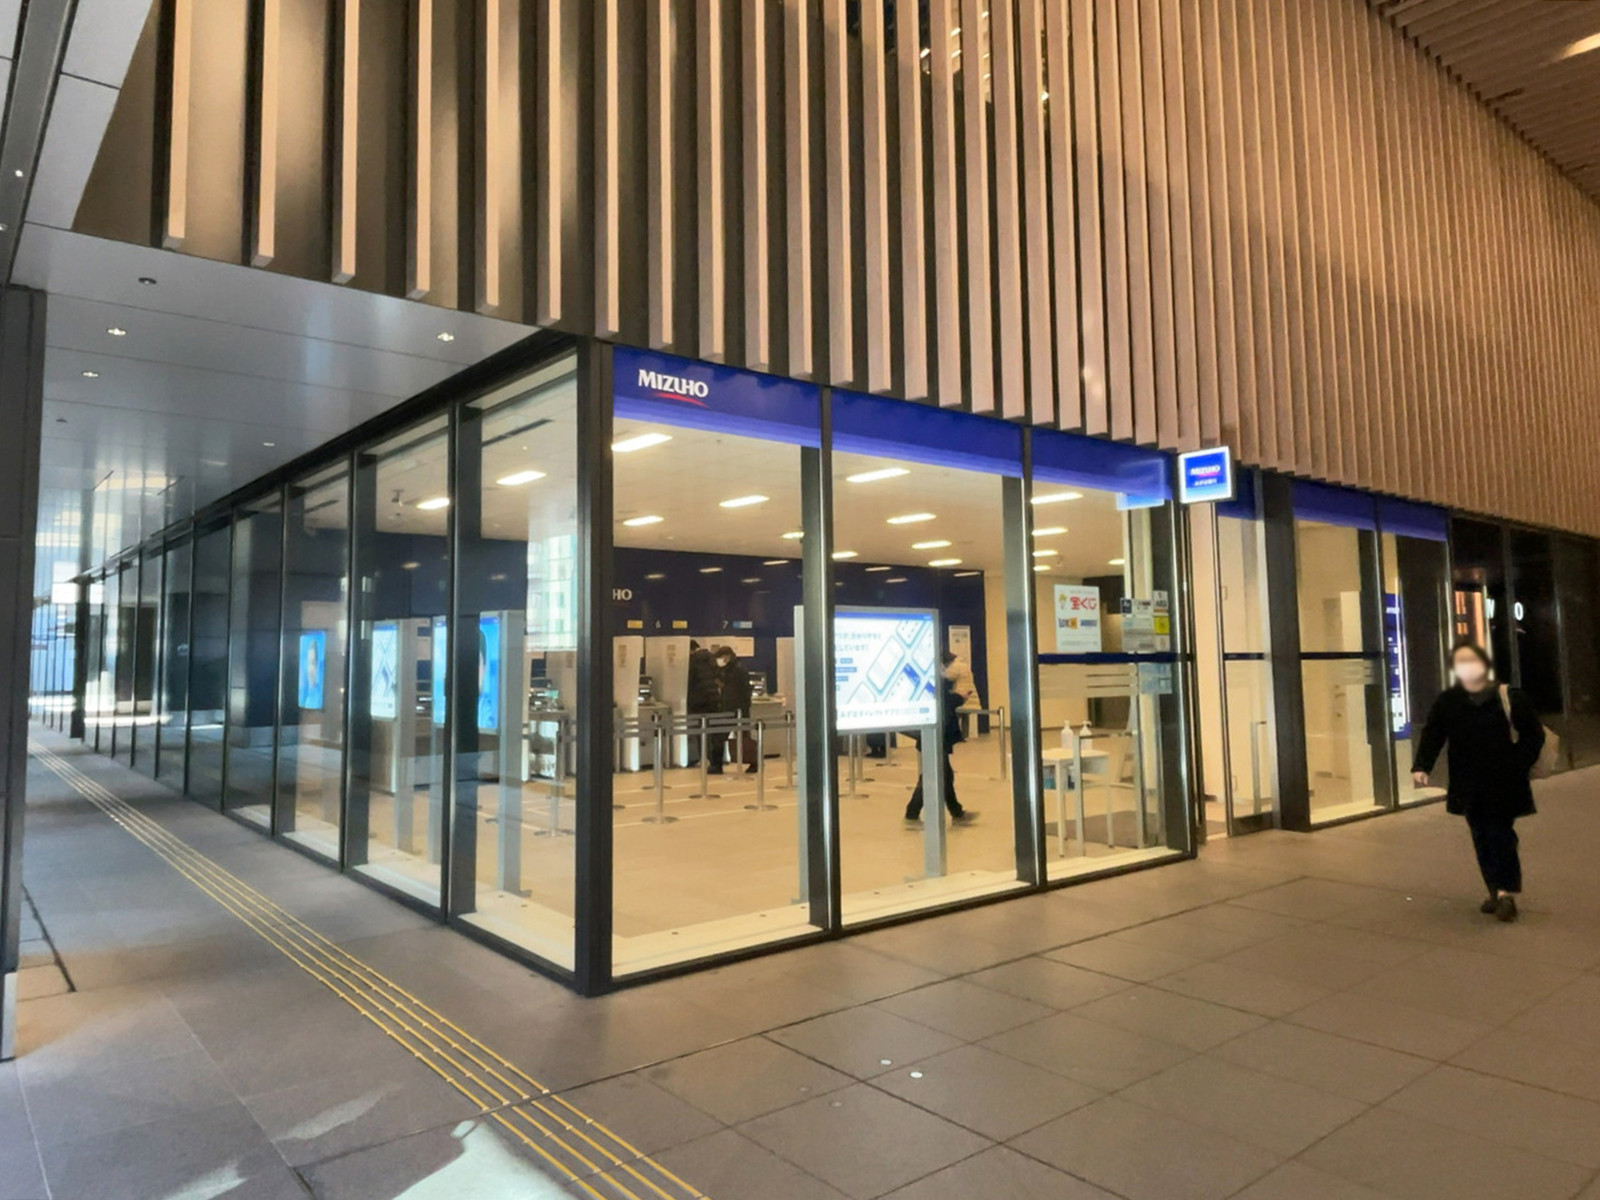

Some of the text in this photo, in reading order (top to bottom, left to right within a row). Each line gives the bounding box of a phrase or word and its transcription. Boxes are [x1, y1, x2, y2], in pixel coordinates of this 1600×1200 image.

[638, 369, 709, 397] MIZUHO
[1069, 595, 1098, 611] 宝くじ
